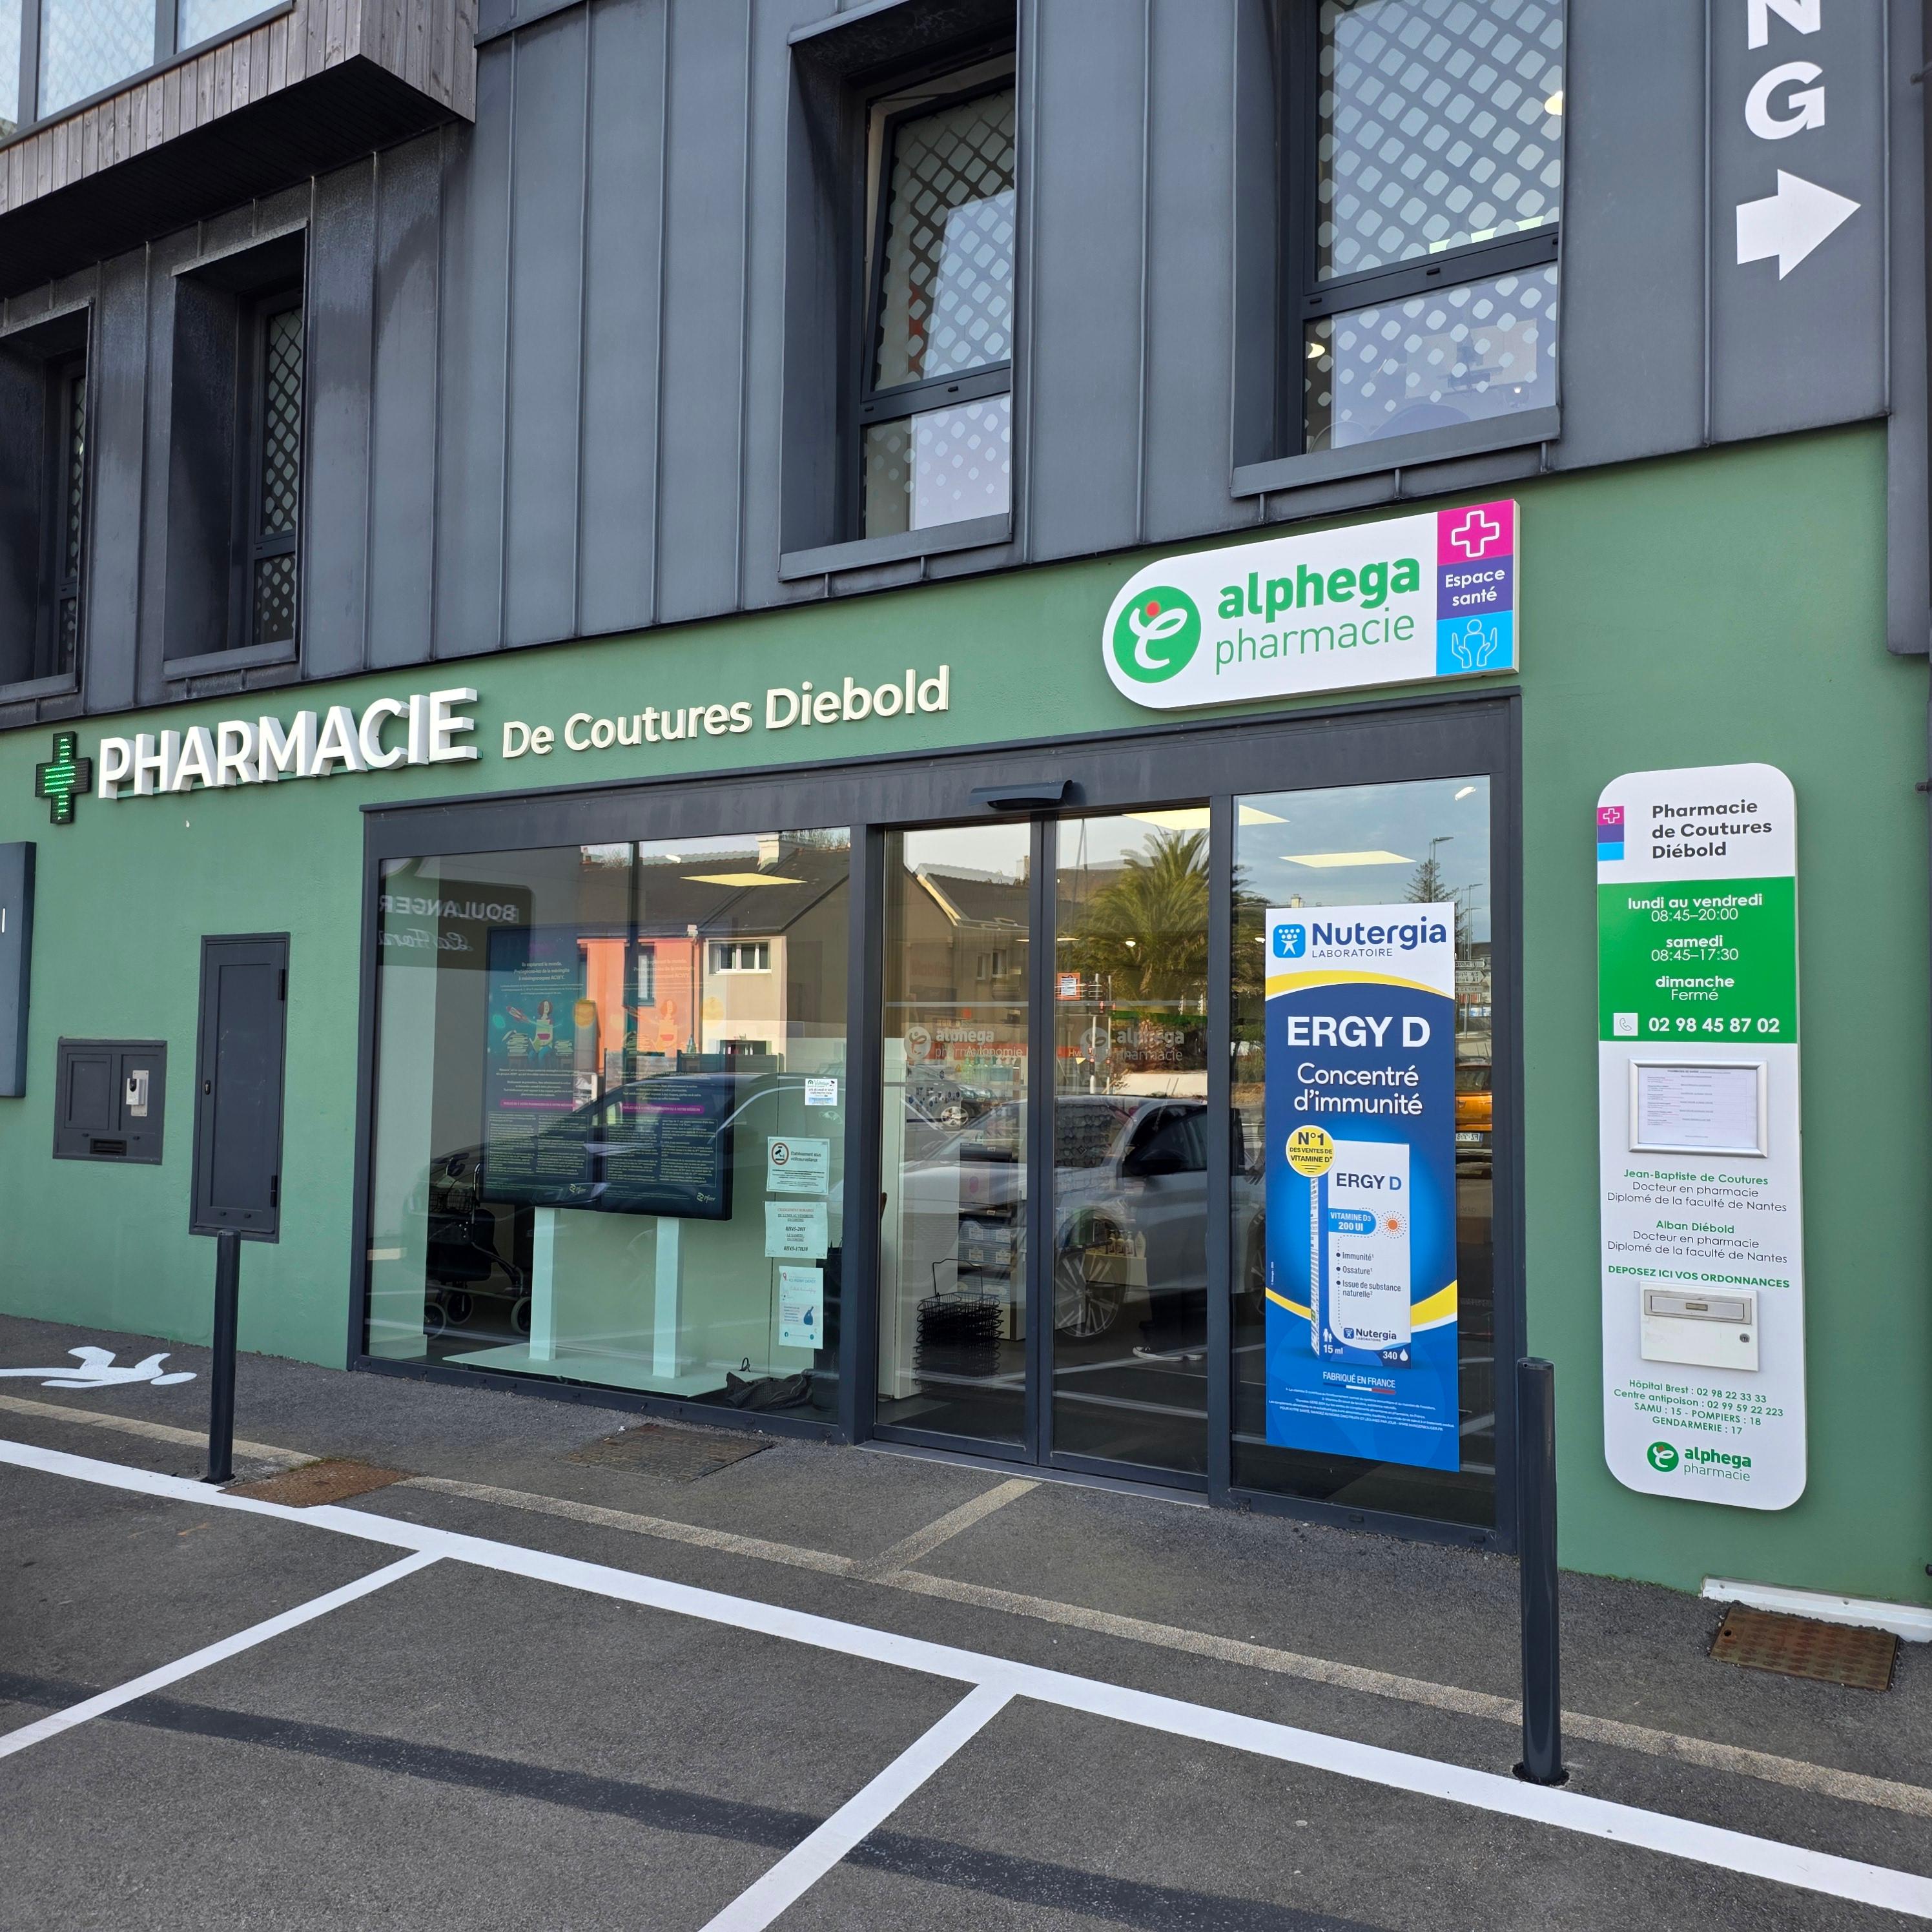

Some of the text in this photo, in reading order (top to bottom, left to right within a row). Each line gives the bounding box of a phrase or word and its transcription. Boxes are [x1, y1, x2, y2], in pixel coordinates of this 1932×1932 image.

[1445, 568, 1505, 588] Espace
[1218, 557, 1420, 623] alphega
[1452, 587, 1497, 606] santé
[1215, 608, 1415, 675] pharmacie
[502, 664, 949, 759] De Coutures Diebold
[99, 688, 477, 799] PHARMACIE
[1652, 799, 1757, 819] Pharmacie
[1652, 821, 1772, 838] de Coutures
[1652, 843, 1726, 858] Diébold
[1628, 894, 1762, 909] lundi au vendredi
[1313, 916, 1446, 950] Nutergia
[1666, 936, 1722, 948] samedi
[1313, 949, 1392, 958] LABORATOIRE
[1656, 976, 1734, 987] dimanche
[1671, 989, 1718, 1000] Fermé
[1288, 1016, 1430, 1047] ERGY D
[1649, 1018, 1780, 1033] 02 98 45 87 02
[1297, 1062, 1419, 1086] Concentré
[1294, 1089, 1423, 1115] d'immunité
[1337, 1173, 1401, 1190] ERGY D
[1624, 1169, 1768, 1185] Jean-Baptiste de Coutures
[1633, 1182, 1758, 1198] Docteur en pharmacie
[1608, 1193, 1787, 1212] Diplomé de la faculté de Nantes
[1330, 1212, 1362, 1220] VITAMINE
[1339, 1222, 1353, 1231] 200
[1656, 1220, 1734, 1234] Alban Diébold
[1634, 1231, 1759, 1248] Docteur en pharmacie
[1608, 1242, 1787, 1264] Diplomé de la faculté de Nantes
[1343, 1280, 1359, 1288] Issue
[1369, 1283, 1401, 1291] substance
[1608, 1266, 1656, 1277] DEPOSEZ
[1675, 1271, 1698, 1280] VOS
[1701, 1273, 1790, 1288] ORDONNANCES
[1356, 1328, 1397, 1341] Nutergia
[1323, 1344, 1333, 1353] 15
[1383, 1351, 1397, 1360] 340
[1323, 1372, 1395, 1388] FABRIQUÉ EN FRANCE
[1629, 1379, 1663, 1391] Hôpital
[1666, 1384, 1688, 1394] Brest
[1697, 1388, 1708, 1396] 02
[1711, 1389, 1723, 1397] 98
[1725, 1391, 1737, 1399] 22
[1740, 1393, 1752, 1401] 33
[1755, 1395, 1766, 1403] 33
[1614, 1389, 1645, 1400] Centre
[1649, 1393, 1698, 1407] antipoison
[1751, 1406, 1762, 1414] 22
[1765, 1408, 1783, 1416] 223
[1634, 1403, 1662, 1413] SAMU
[1671, 1407, 1681, 1415] 15
[1692, 1410, 1740, 1423] POMPIERS
[1652, 1416, 1722, 1433] GENDARMERIE
[1731, 1426, 1742, 1435] 17
[1685, 1446, 1752, 1468] alphega
[1684, 1463, 1751, 1481] pharmacie
